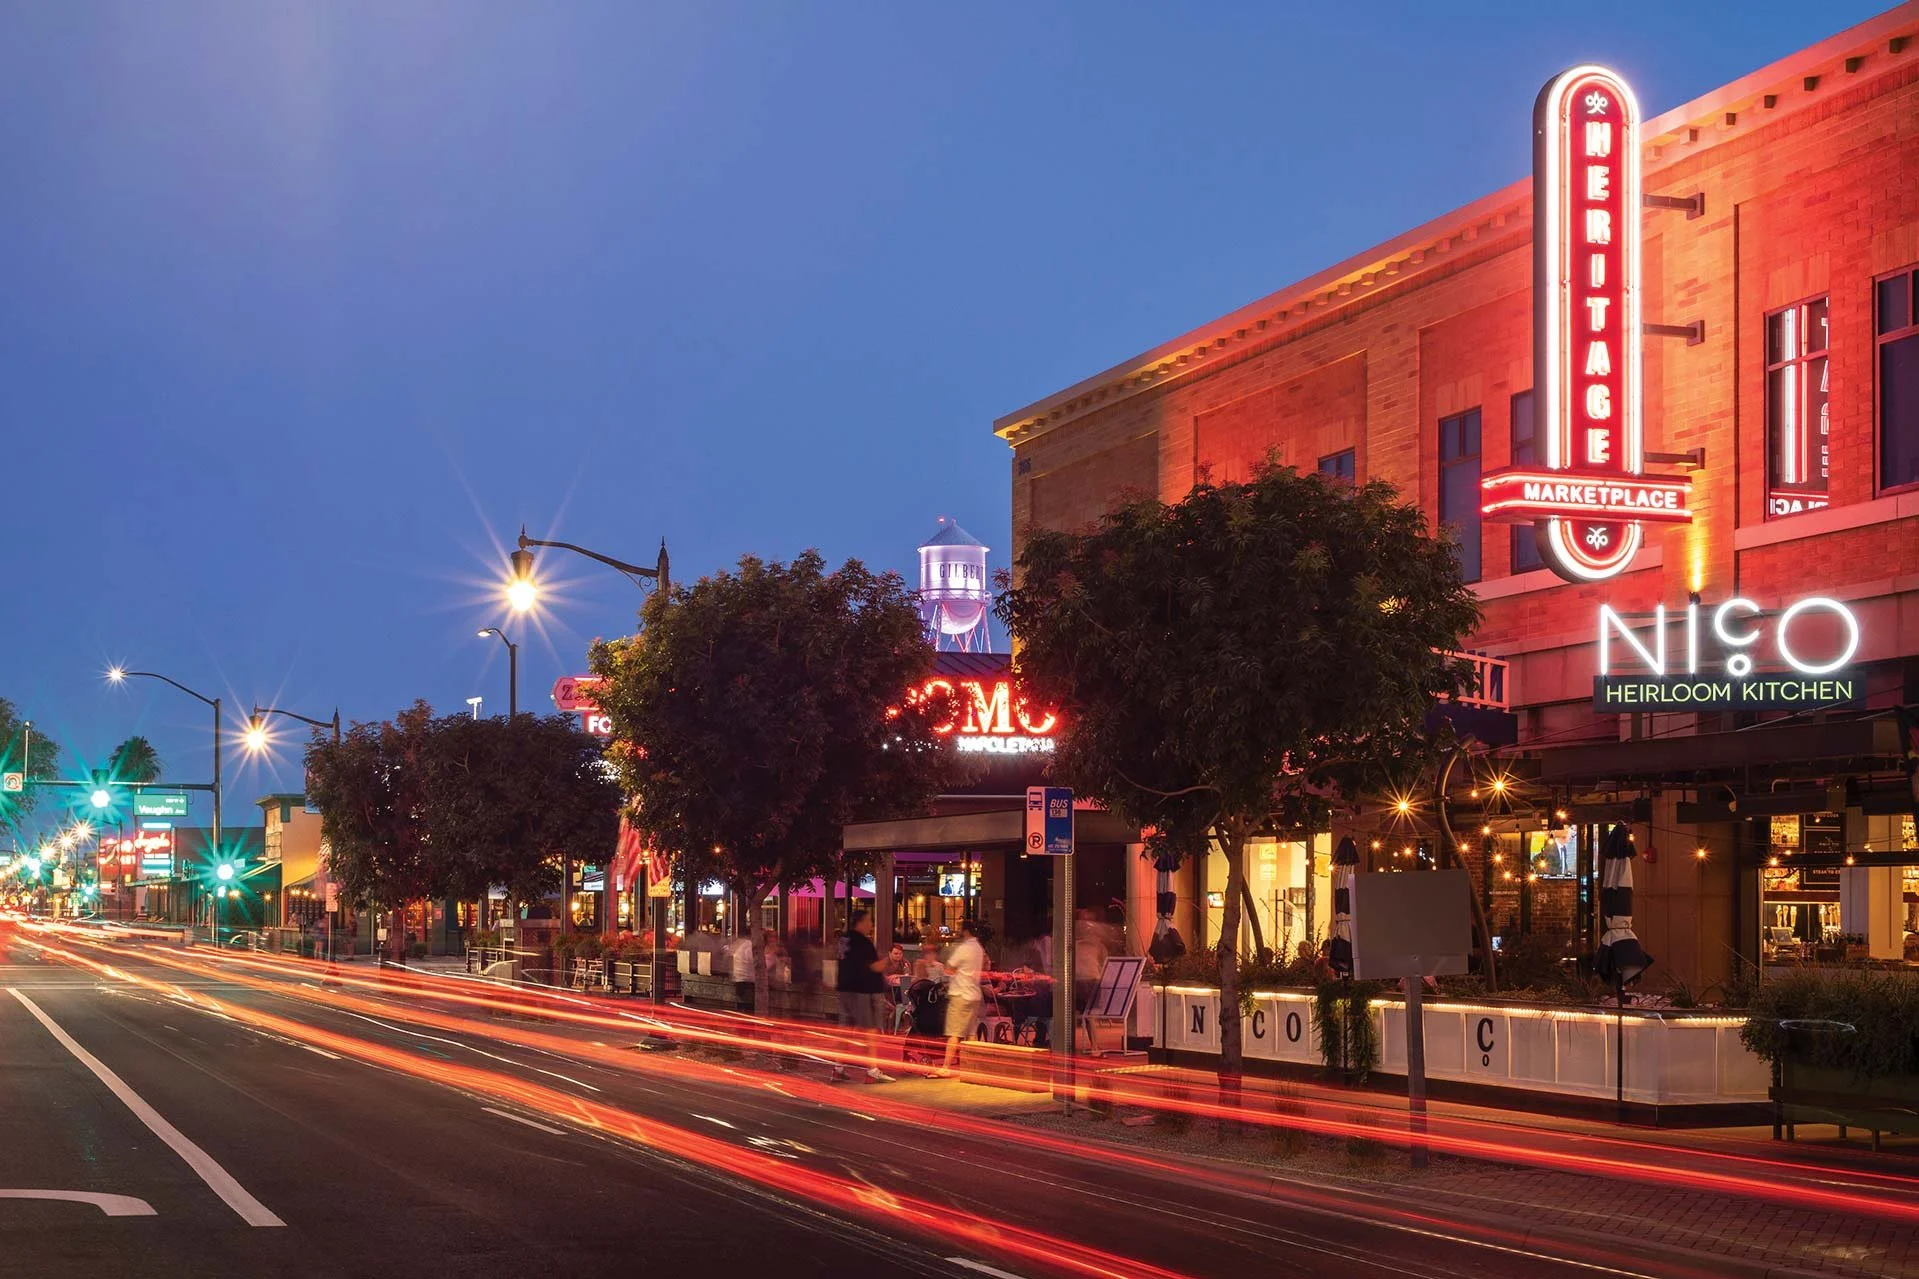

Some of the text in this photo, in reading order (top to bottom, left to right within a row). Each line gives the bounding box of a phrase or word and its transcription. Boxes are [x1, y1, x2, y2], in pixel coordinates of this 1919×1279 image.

[1586, 121, 1612, 464] HERITAGE
[1523, 482, 1678, 509] MARKETPLACE
[1606, 681, 1853, 703] HEIRLOOM KITCHEN
[138, 805, 173, 815] Vaughn
[1049, 798, 1069, 809] BUS
